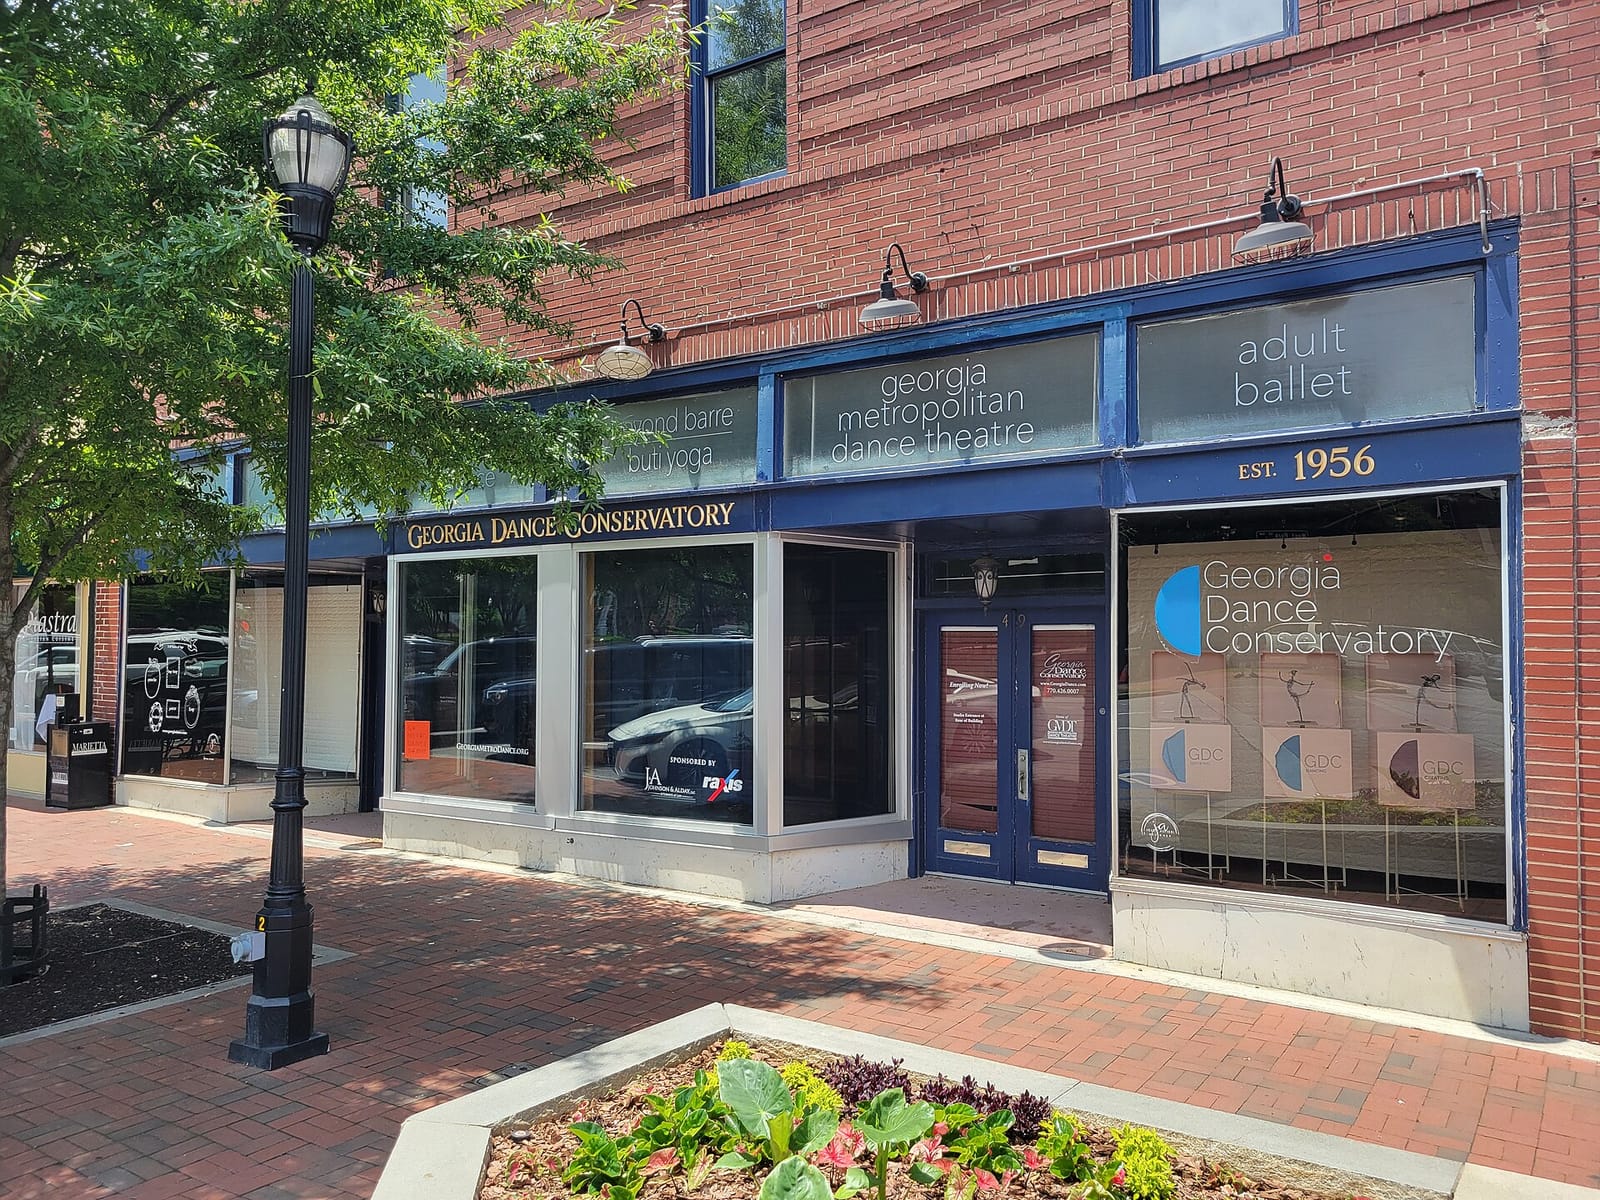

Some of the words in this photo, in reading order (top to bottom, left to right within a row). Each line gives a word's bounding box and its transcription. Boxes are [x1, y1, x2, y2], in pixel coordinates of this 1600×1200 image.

[1238, 317, 1346, 365] adult
[881, 358, 986, 404] georgia
[1235, 363, 1352, 407] ballet
[684, 406, 734, 431] barre
[838, 386, 1024, 432] metropolitan
[831, 433, 916, 463] dance
[924, 421, 1034, 454] theatre
[628, 445, 661, 473] buti
[665, 446, 713, 477] yoga
[1238, 461, 1277, 480] EST.
[1294, 444, 1376, 481] 1956
[407, 521, 485, 550] GEORGIA
[491, 515, 557, 544] DANCE
[563, 502, 736, 539] CONSERVATORY
[1202, 553, 1341, 598] Georgia
[1205, 595, 1319, 623] Dance
[1205, 626, 1454, 663] Conservatory
[1040, 653, 1086, 674] Georgia
[1054, 667, 1087, 675] Dance
[72, 741, 107, 752] MARIETTA
[669, 756, 707, 766] SPONSORED
[708, 759, 717, 767] BY
[1188, 747, 1224, 762] GDC
[1304, 754, 1342, 769] GDC
[1422, 760, 1465, 776] GDC
[258, 916, 266, 931] 2
